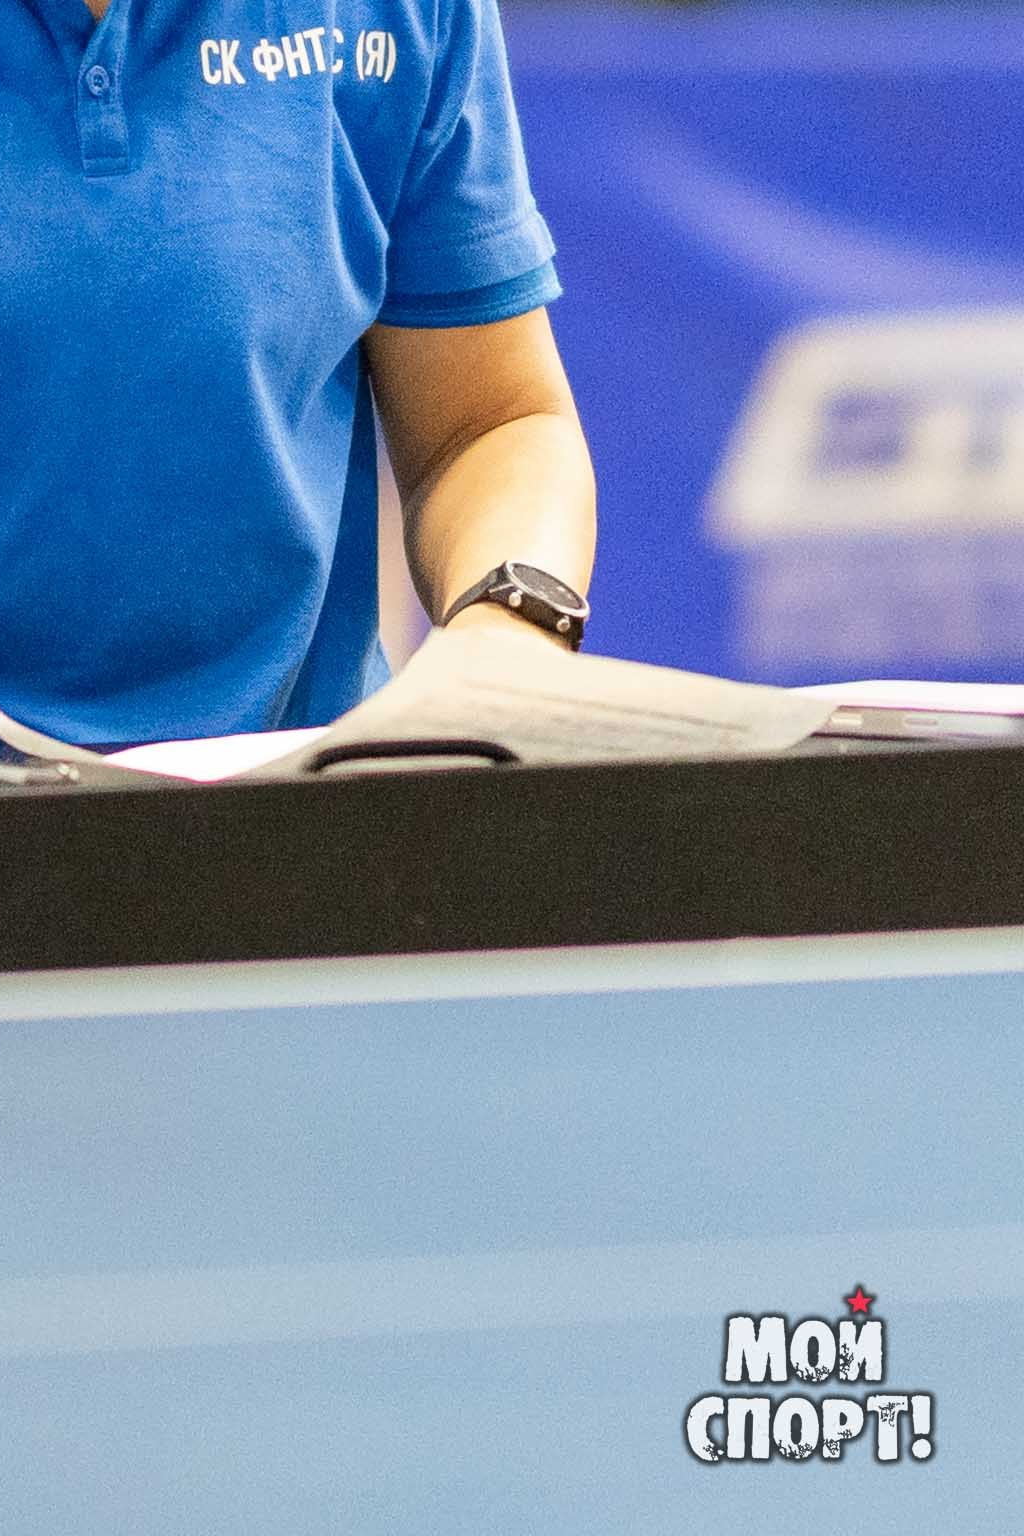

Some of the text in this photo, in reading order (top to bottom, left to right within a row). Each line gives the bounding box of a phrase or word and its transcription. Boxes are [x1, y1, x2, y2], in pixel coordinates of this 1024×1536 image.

[200, 27, 397, 85] СК ФНТС (Я)
